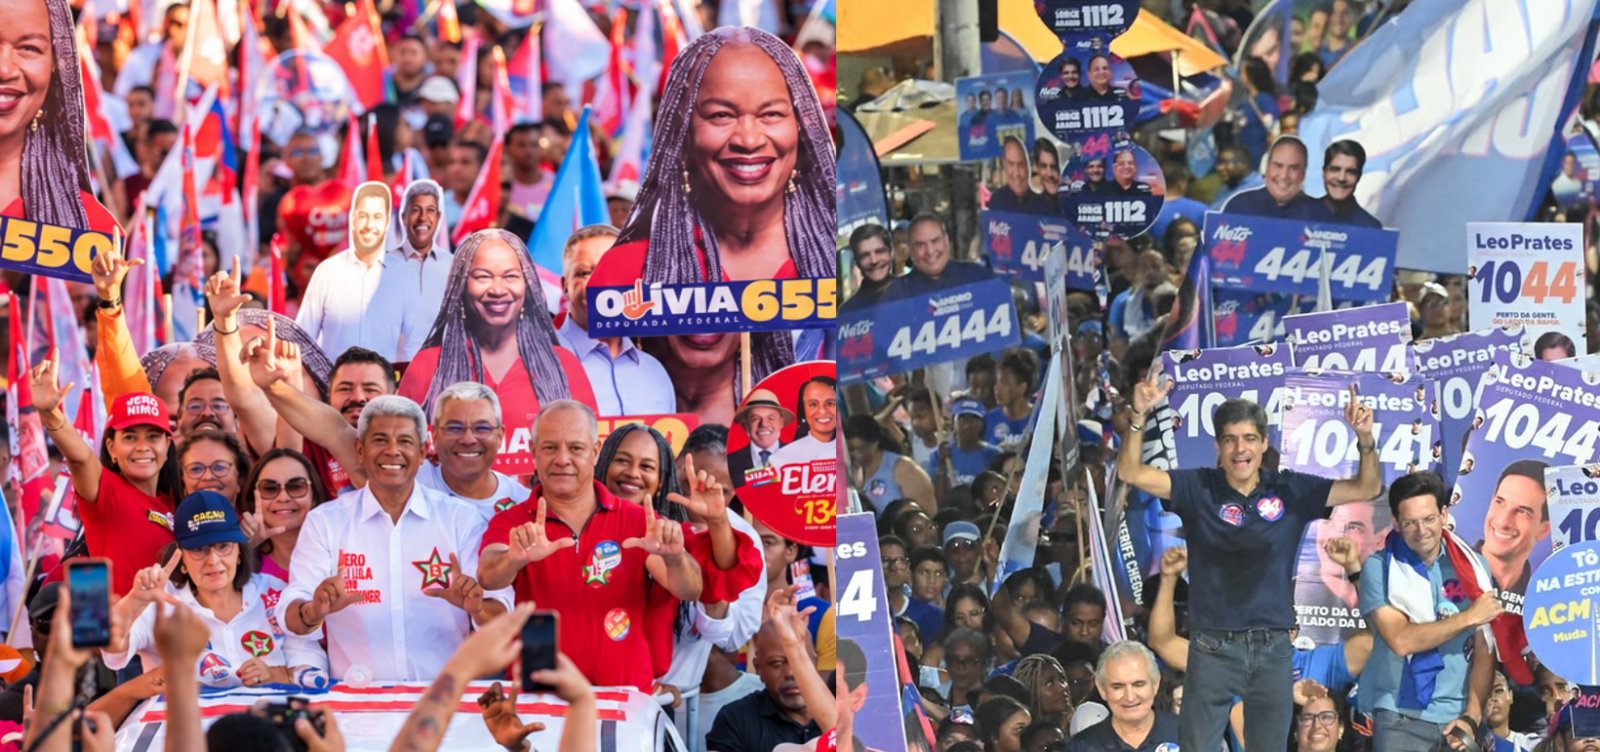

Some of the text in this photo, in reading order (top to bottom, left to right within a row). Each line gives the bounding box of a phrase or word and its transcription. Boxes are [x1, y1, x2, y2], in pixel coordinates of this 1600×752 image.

[1082, 4, 1124, 27] 1112
[1082, 105, 1124, 128] 1112
[1105, 200, 1146, 223] 1112
[1213, 224, 1252, 241] Neto
[0, 216, 113, 275] 550
[1254, 247, 1387, 290] 44444
[1475, 260, 1577, 304] 1044
[596, 316, 739, 329] DEPUTADA FEDERAL
[838, 319, 874, 341] Neto
[887, 303, 1012, 360] 44444
[1496, 385, 1563, 408] DEPUTADO FEDERAL
[127, 405, 159, 416] NIMO
[1484, 397, 1600, 464] 1044
[1556, 478, 1598, 496] Leo
[343, 553, 365, 567] ERO
[836, 541, 867, 560] es
[1572, 549, 1599, 568] Tô
[836, 568, 877, 621] 4
[1536, 576, 1561, 593] NA
[1303, 616, 1336, 627] LADO
[1338, 618, 1356, 628] DA
[1331, 607, 1349, 617] DA
[1529, 598, 1590, 630] ACM
[1553, 629, 1587, 643] Muda
